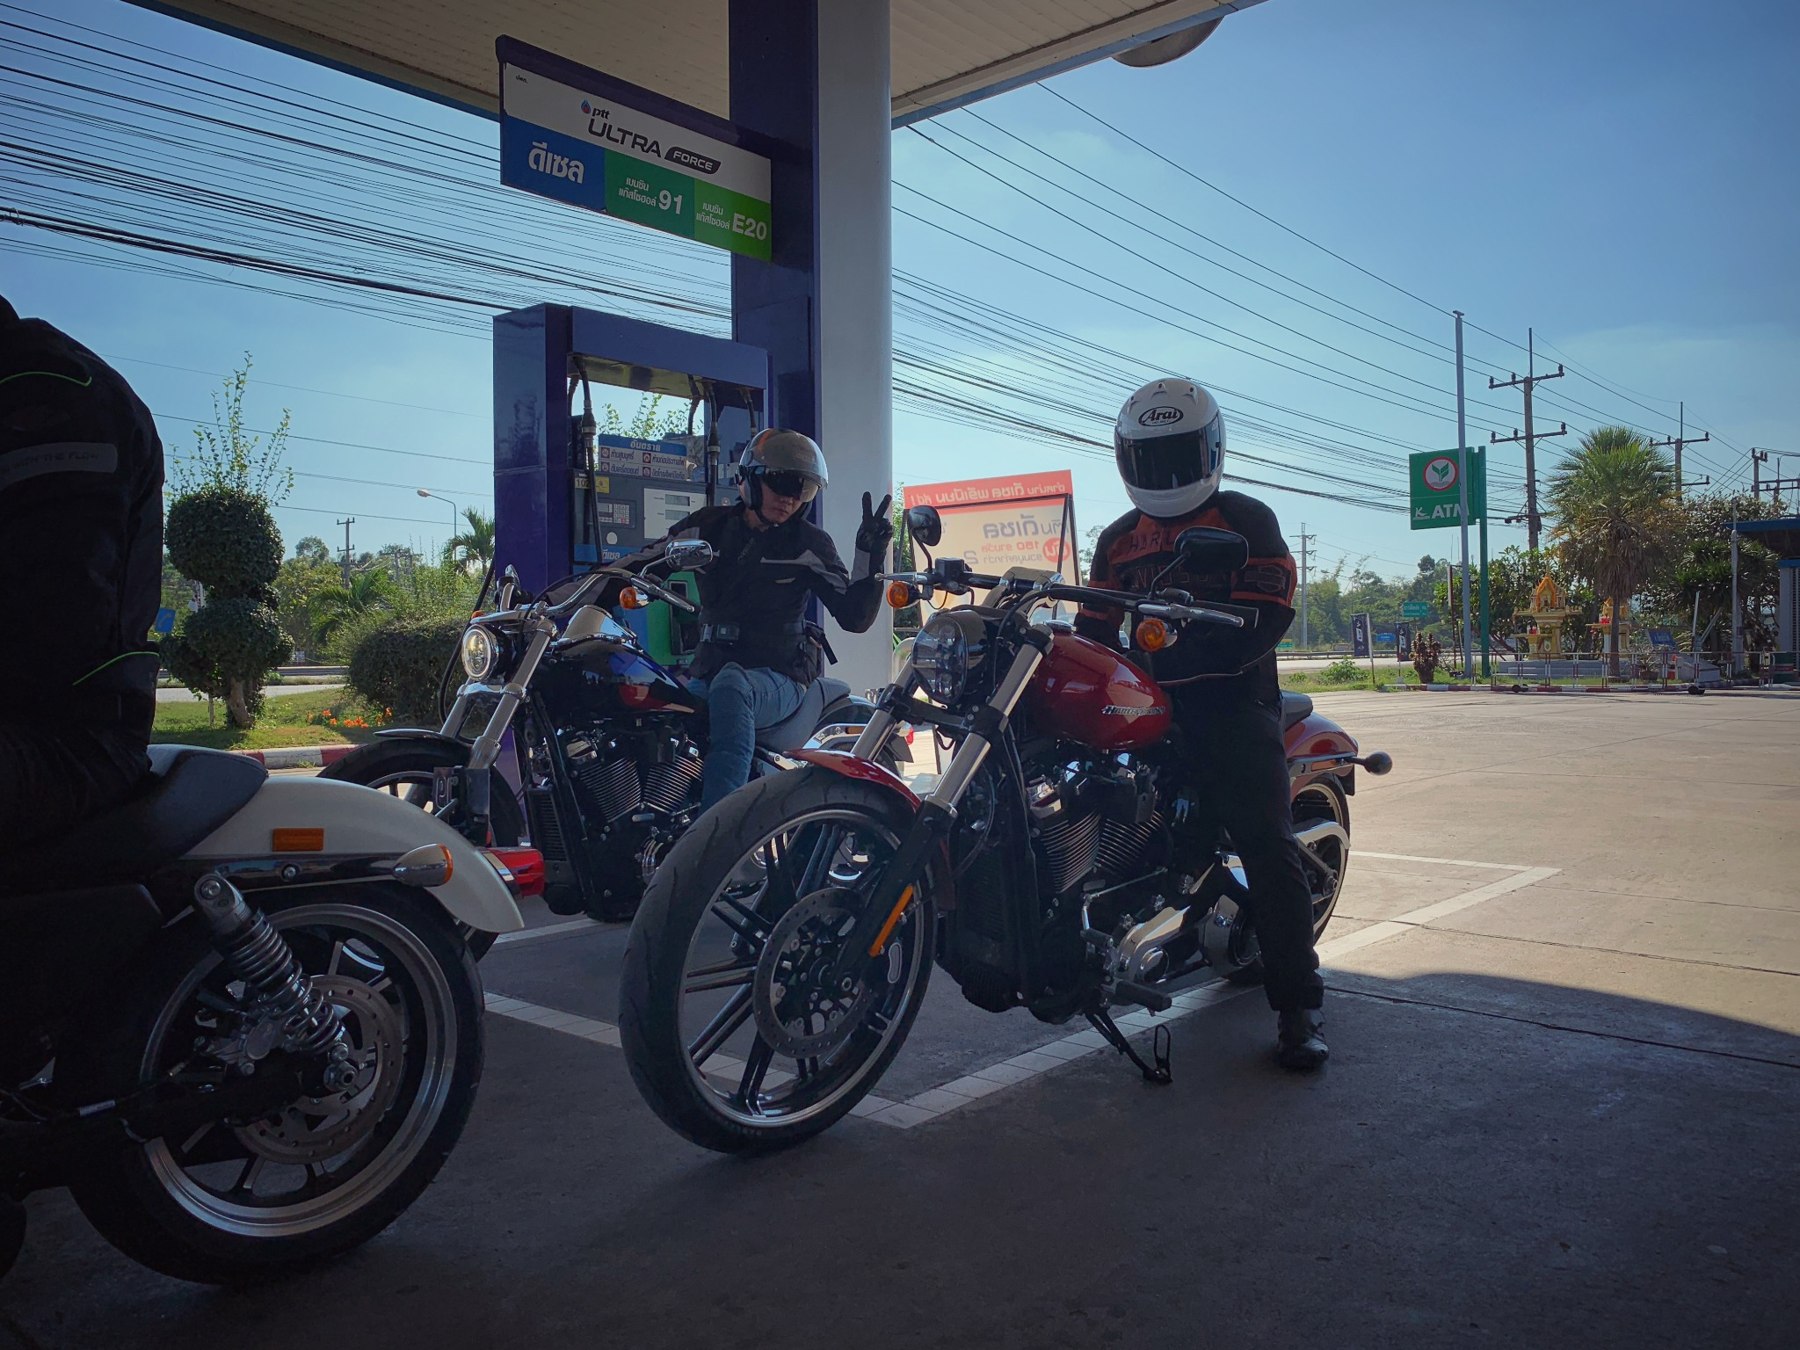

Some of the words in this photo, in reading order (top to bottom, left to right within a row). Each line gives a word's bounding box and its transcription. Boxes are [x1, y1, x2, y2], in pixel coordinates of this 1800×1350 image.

[592, 106, 610, 120] ptt
[588, 118, 661, 158] ULTRA
[673, 150, 714, 171] FORCE
[528, 141, 585, 185] ดีเซล
[625, 177, 650, 192] เบนซิน
[658, 189, 683, 215] 91
[732, 212, 768, 241] E20
[1143, 409, 1178, 423] Arai
[630, 440, 661, 452] อันตราย
